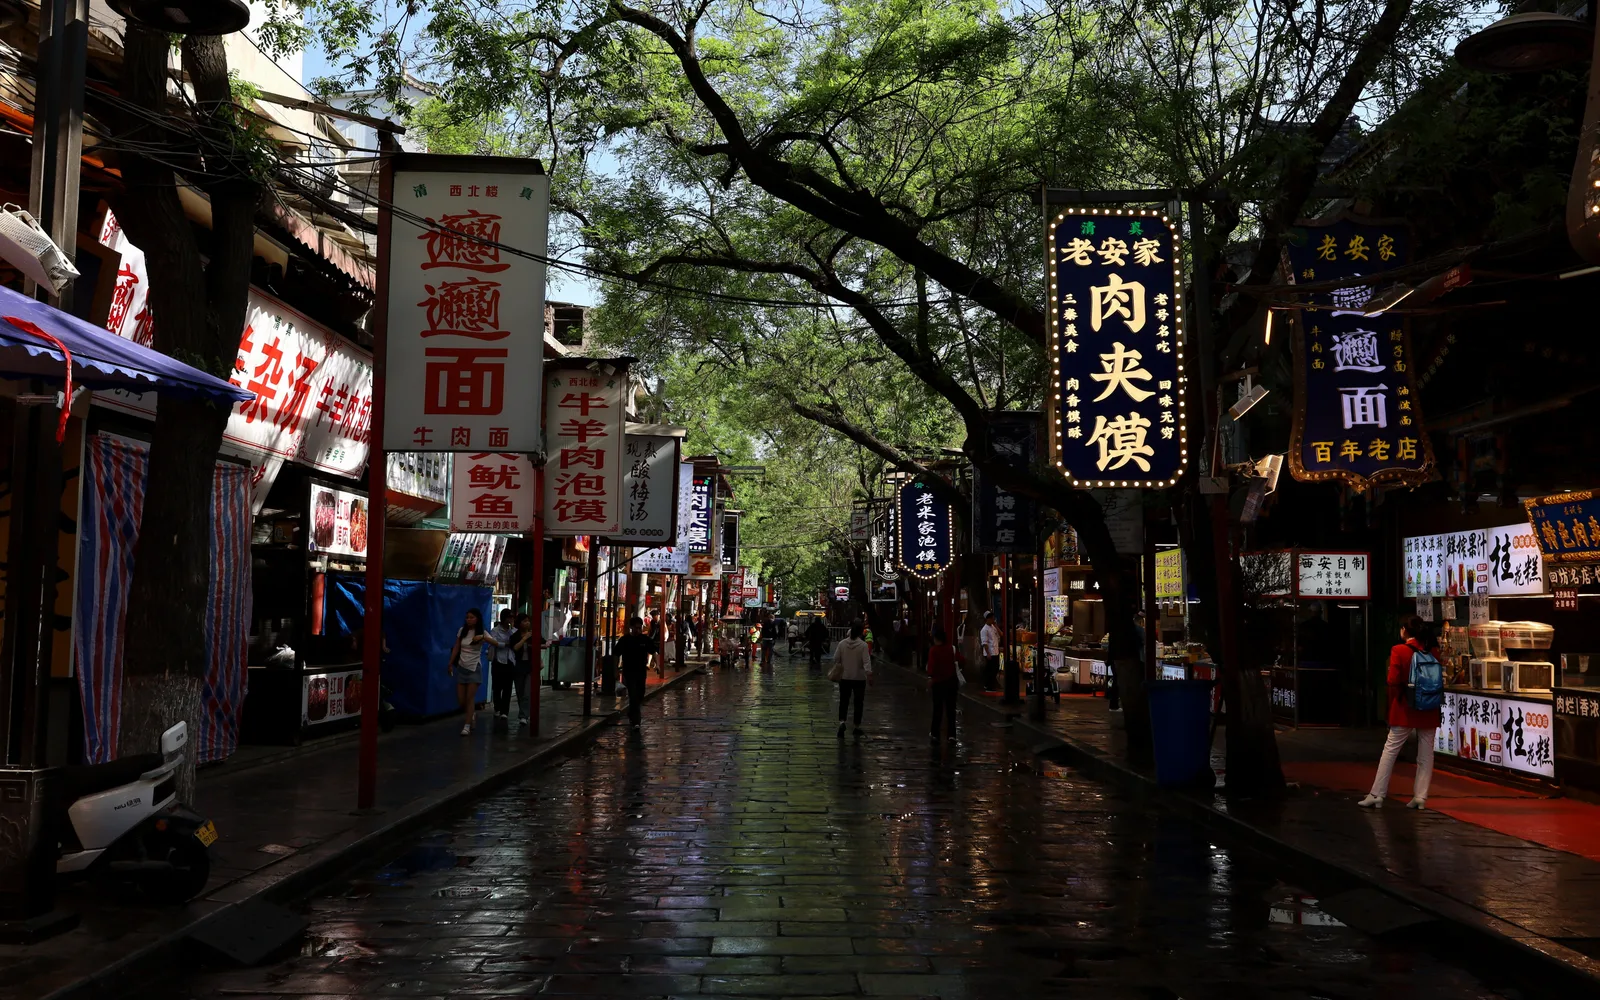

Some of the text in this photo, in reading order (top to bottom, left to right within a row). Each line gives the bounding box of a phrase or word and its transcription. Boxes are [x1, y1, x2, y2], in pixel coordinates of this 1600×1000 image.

[413, 183, 533, 201] 清 西北楼 真
[1061, 237, 1165, 267] 老安家
[1317, 234, 1397, 262] 老安家
[1310, 325, 1325, 370] 牛肉面
[569, 377, 598, 387] 西北楼
[1086, 273, 1156, 472] 肉夹馍
[1158, 379, 1175, 440] 回味无穷
[413, 427, 509, 447] 牛肉面
[552, 392, 609, 524] 牛羊肉泡馍
[1311, 438, 1418, 463] 百年老店
[467, 452, 521, 519] 鱿鱼
[629, 460, 651, 522] 酸梅汤
[465, 520, 520, 530] 舌尖上的美味
[916, 493, 937, 562] 老米家泡馍
[995, 486, 1016, 544] 特产店
[1302, 556, 1365, 570] 西安自制
[1489, 534, 1541, 587] 桂花糕
[1503, 707, 1553, 767] 桂花糕
